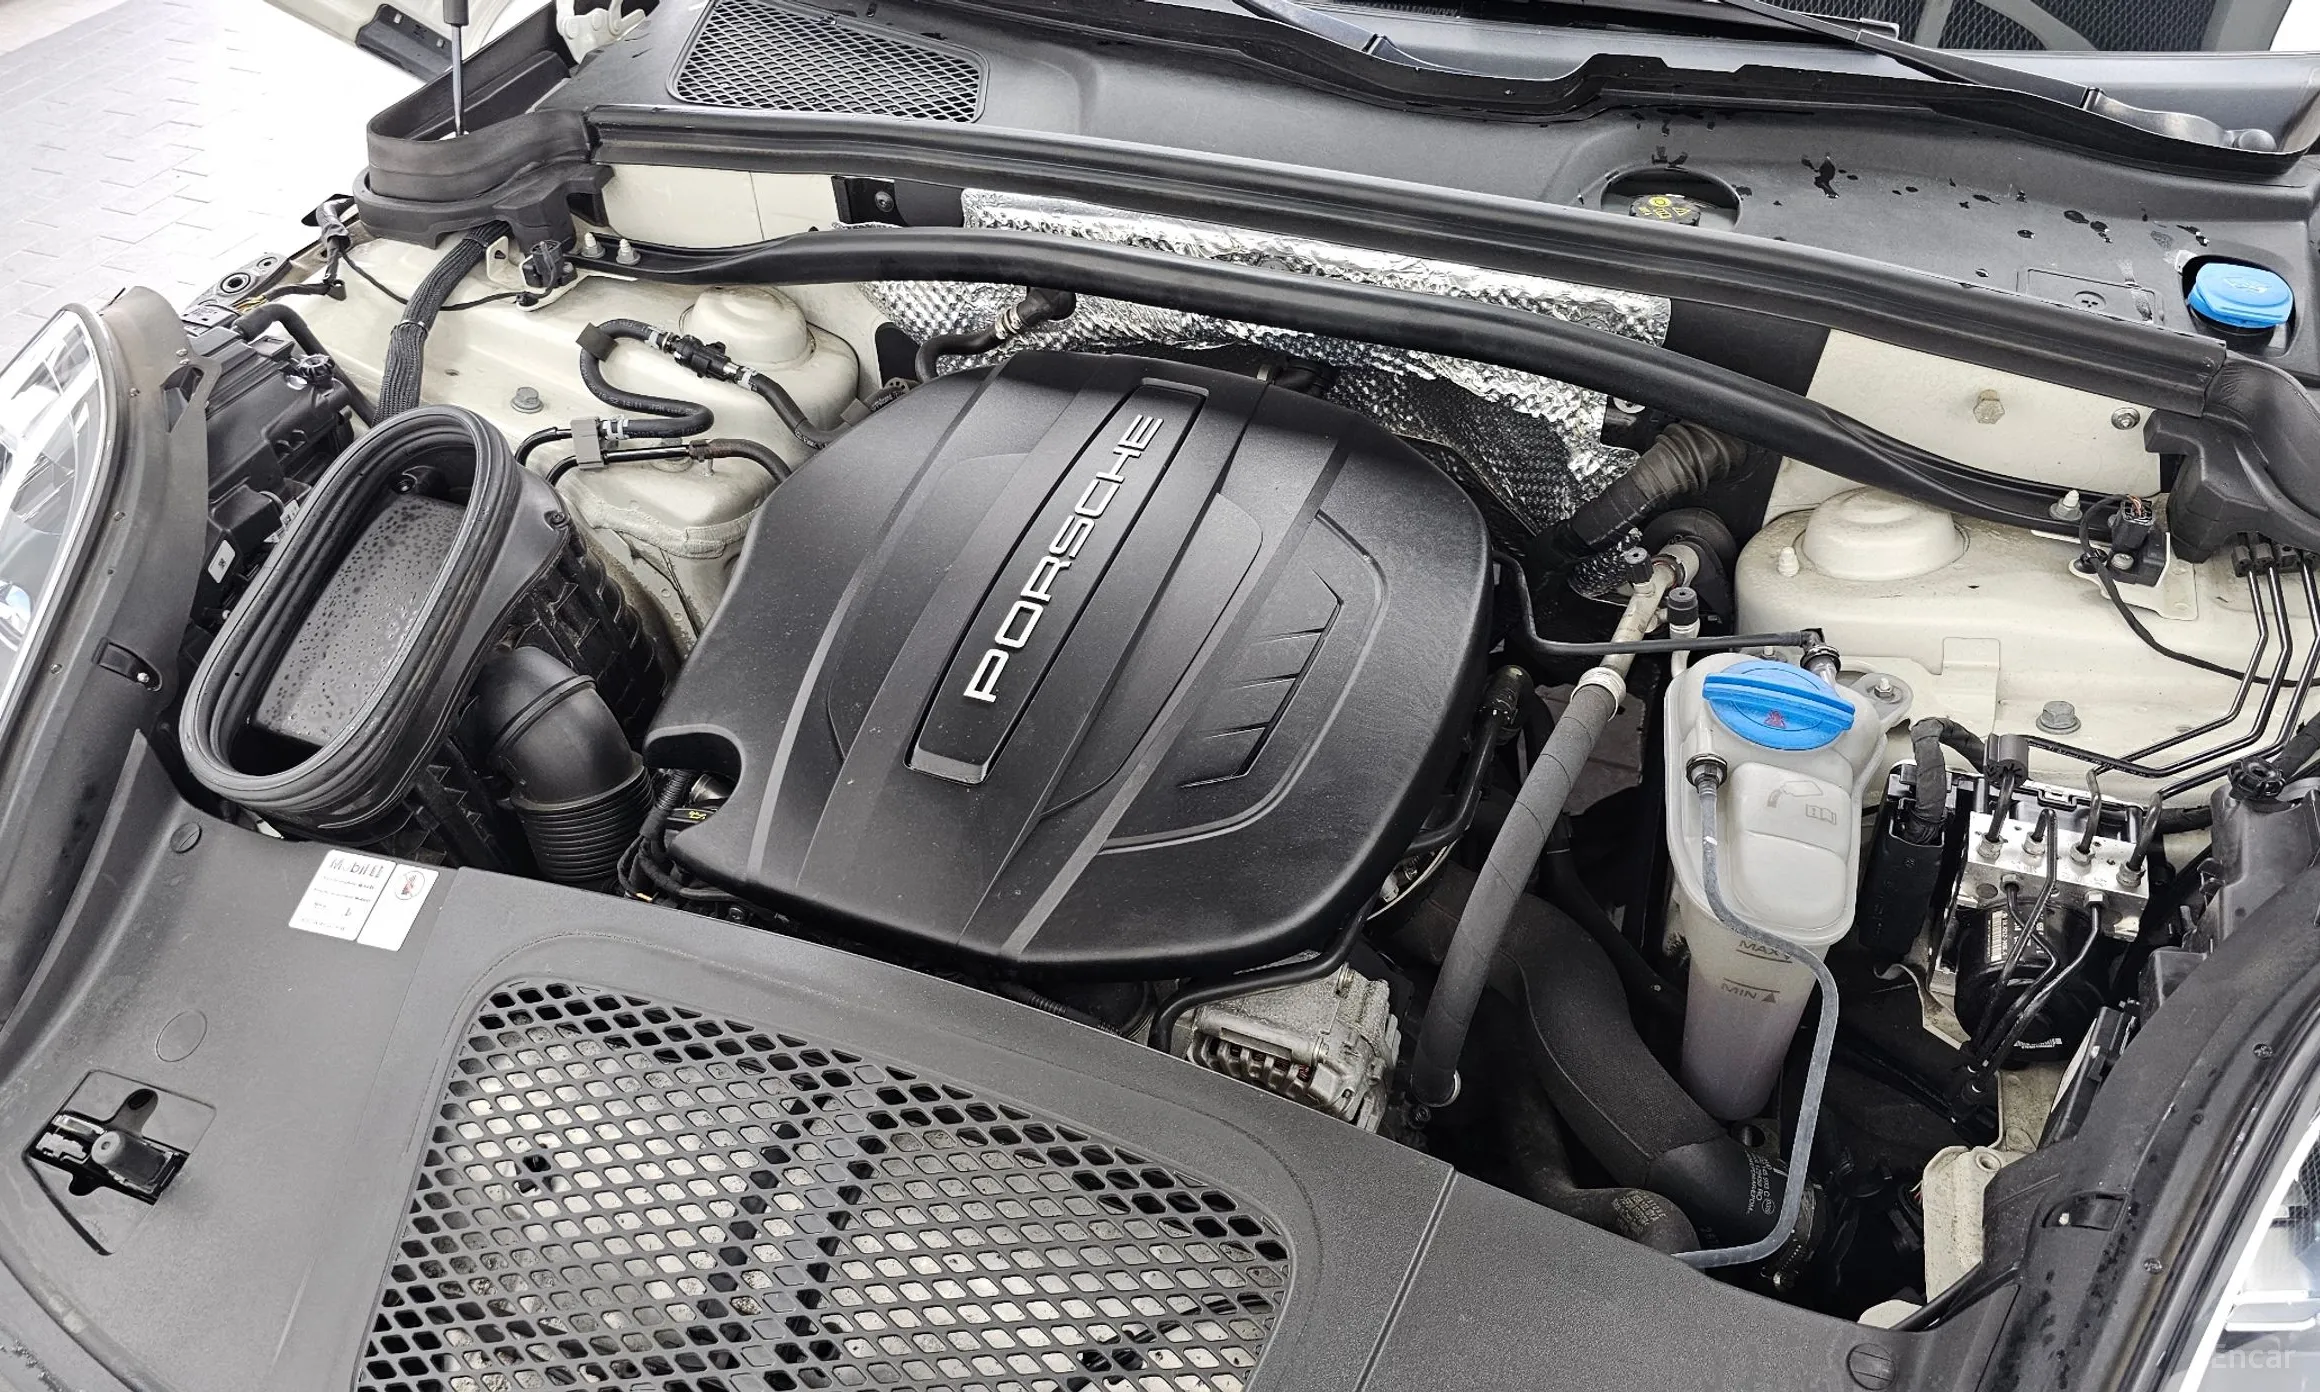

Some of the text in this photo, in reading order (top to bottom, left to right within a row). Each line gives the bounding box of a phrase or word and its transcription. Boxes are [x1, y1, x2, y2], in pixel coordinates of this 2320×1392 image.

[963, 414, 1164, 703] PORSCHE
[1739, 939, 1779, 956] MAX
[1720, 983, 1757, 1000] MIN
